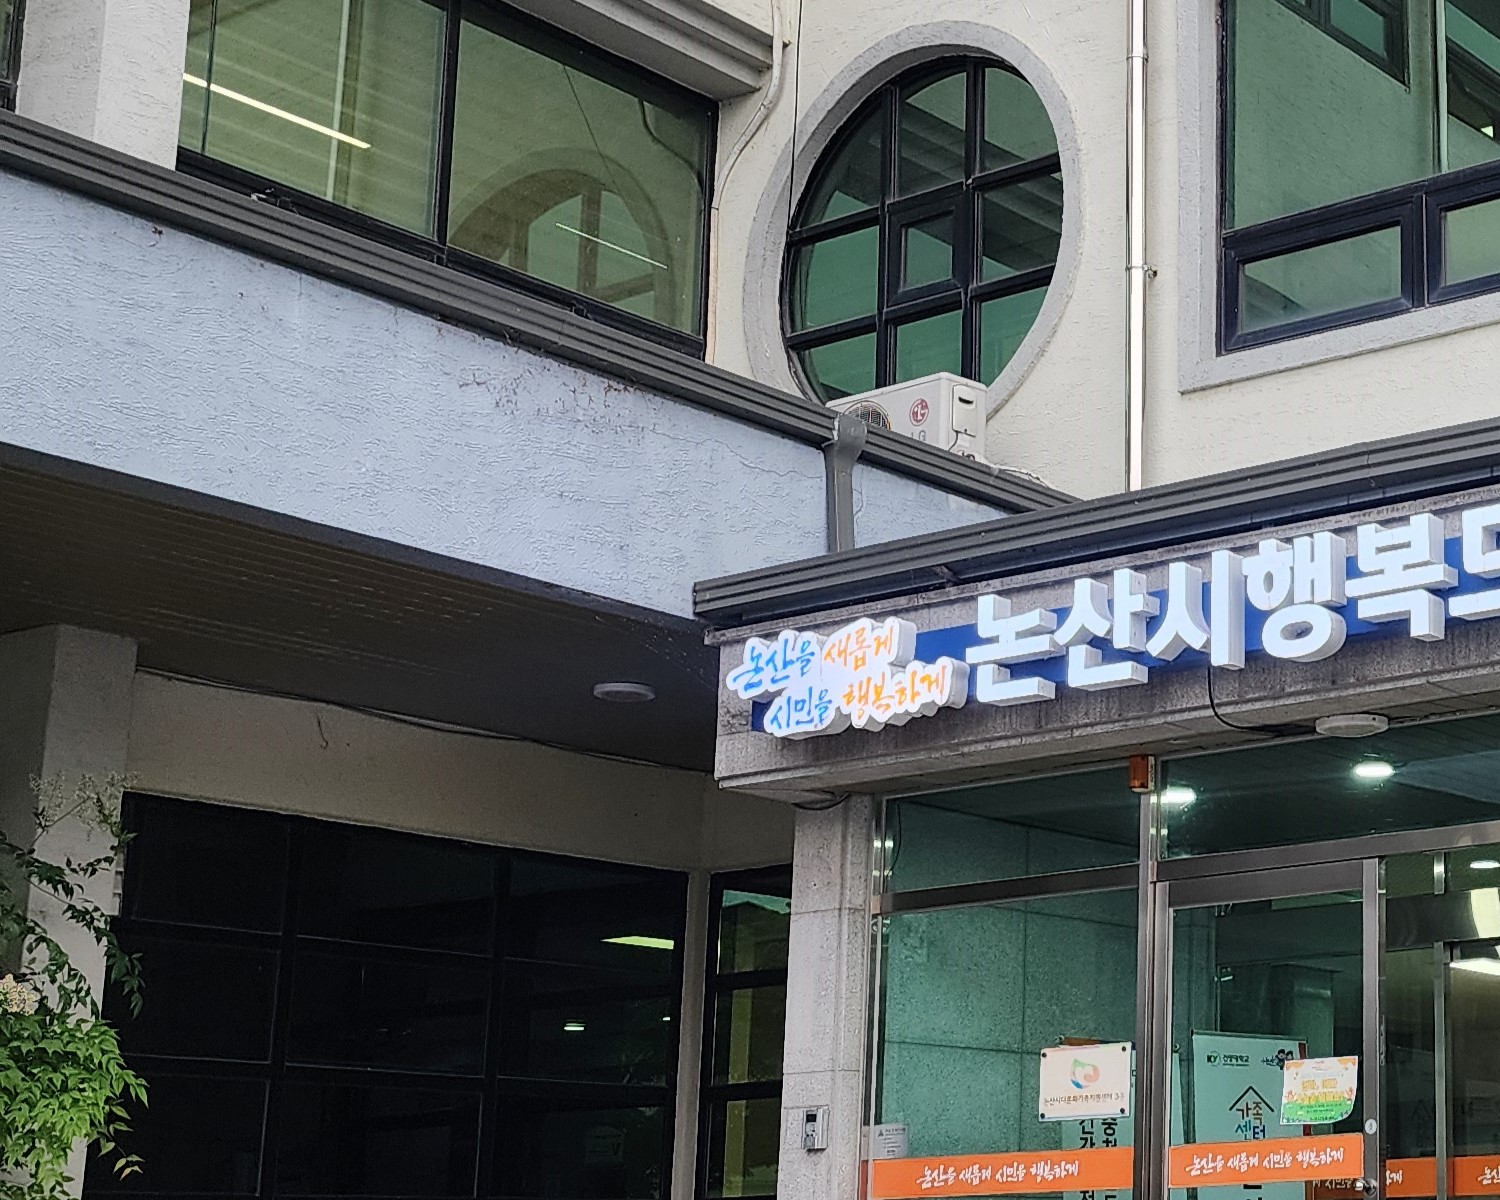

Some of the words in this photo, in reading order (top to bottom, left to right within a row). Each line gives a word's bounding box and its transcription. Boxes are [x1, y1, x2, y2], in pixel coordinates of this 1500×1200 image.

[732, 638, 816, 693] 논산을
[823, 625, 894, 672] 새롭게
[770, 687, 833, 730] 시민을
[842, 664, 947, 720] 행복하게
[1236, 1101, 1263, 1126] 가족
[1235, 1119, 1266, 1140] 센터
[915, 1164, 956, 1189] 논산을
[958, 1163, 992, 1185] 새롭게
[996, 1161, 1026, 1183] 시민을
[1030, 1160, 1079, 1183] 행복하게
[1185, 1153, 1224, 1177] 논산을
[1227, 1151, 1259, 1172] 새롭게
[1262, 1149, 1293, 1169] 시민을
[1296, 1147, 1344, 1169] 행복하게
